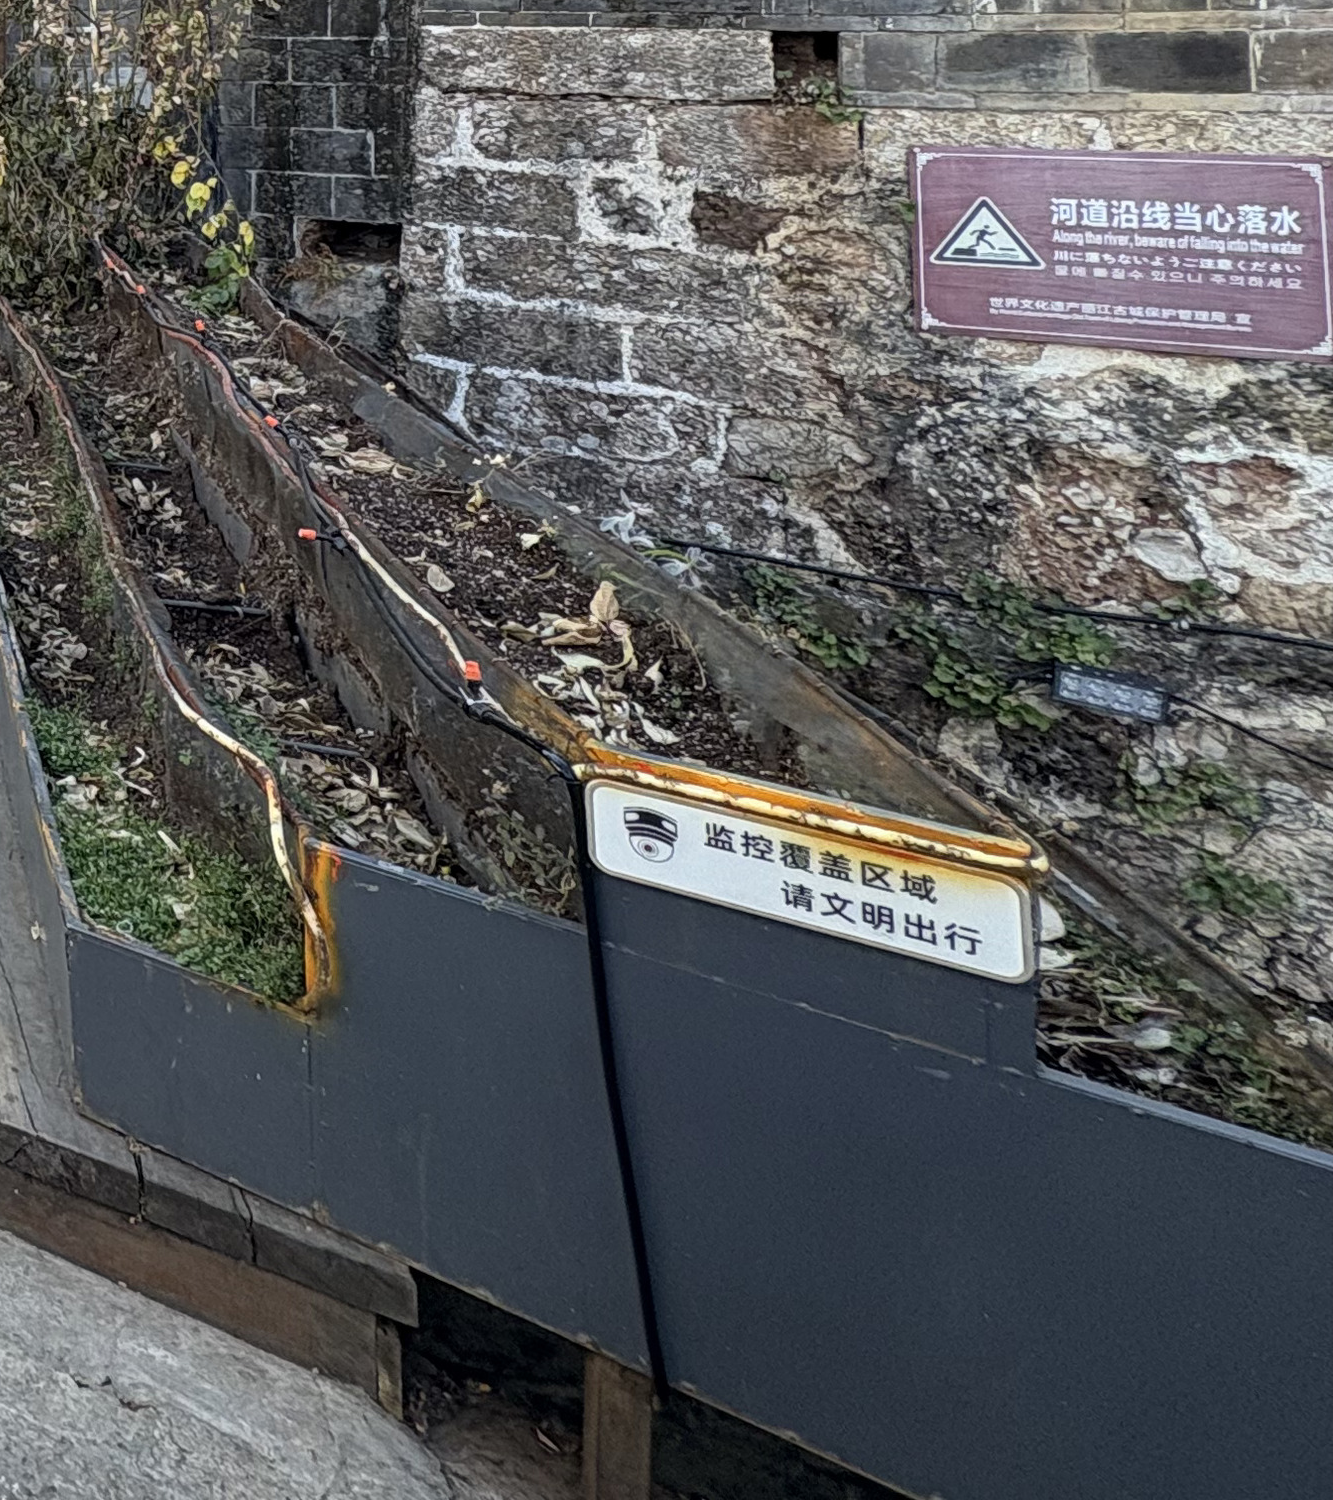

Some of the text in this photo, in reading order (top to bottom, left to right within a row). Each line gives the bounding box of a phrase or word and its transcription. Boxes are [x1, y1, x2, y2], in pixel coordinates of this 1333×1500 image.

[1050, 198, 1302, 236] 河道沿线当心落水
[1052, 229, 1084, 246] Along
[1085, 230, 1102, 245] the
[1104, 231, 1133, 248] river,
[1134, 233, 1176, 249] beware
[1177, 235, 1189, 249] of
[703, 822, 938, 904] 监控覆盖区域
[780, 880, 983, 956] 请文明出行
